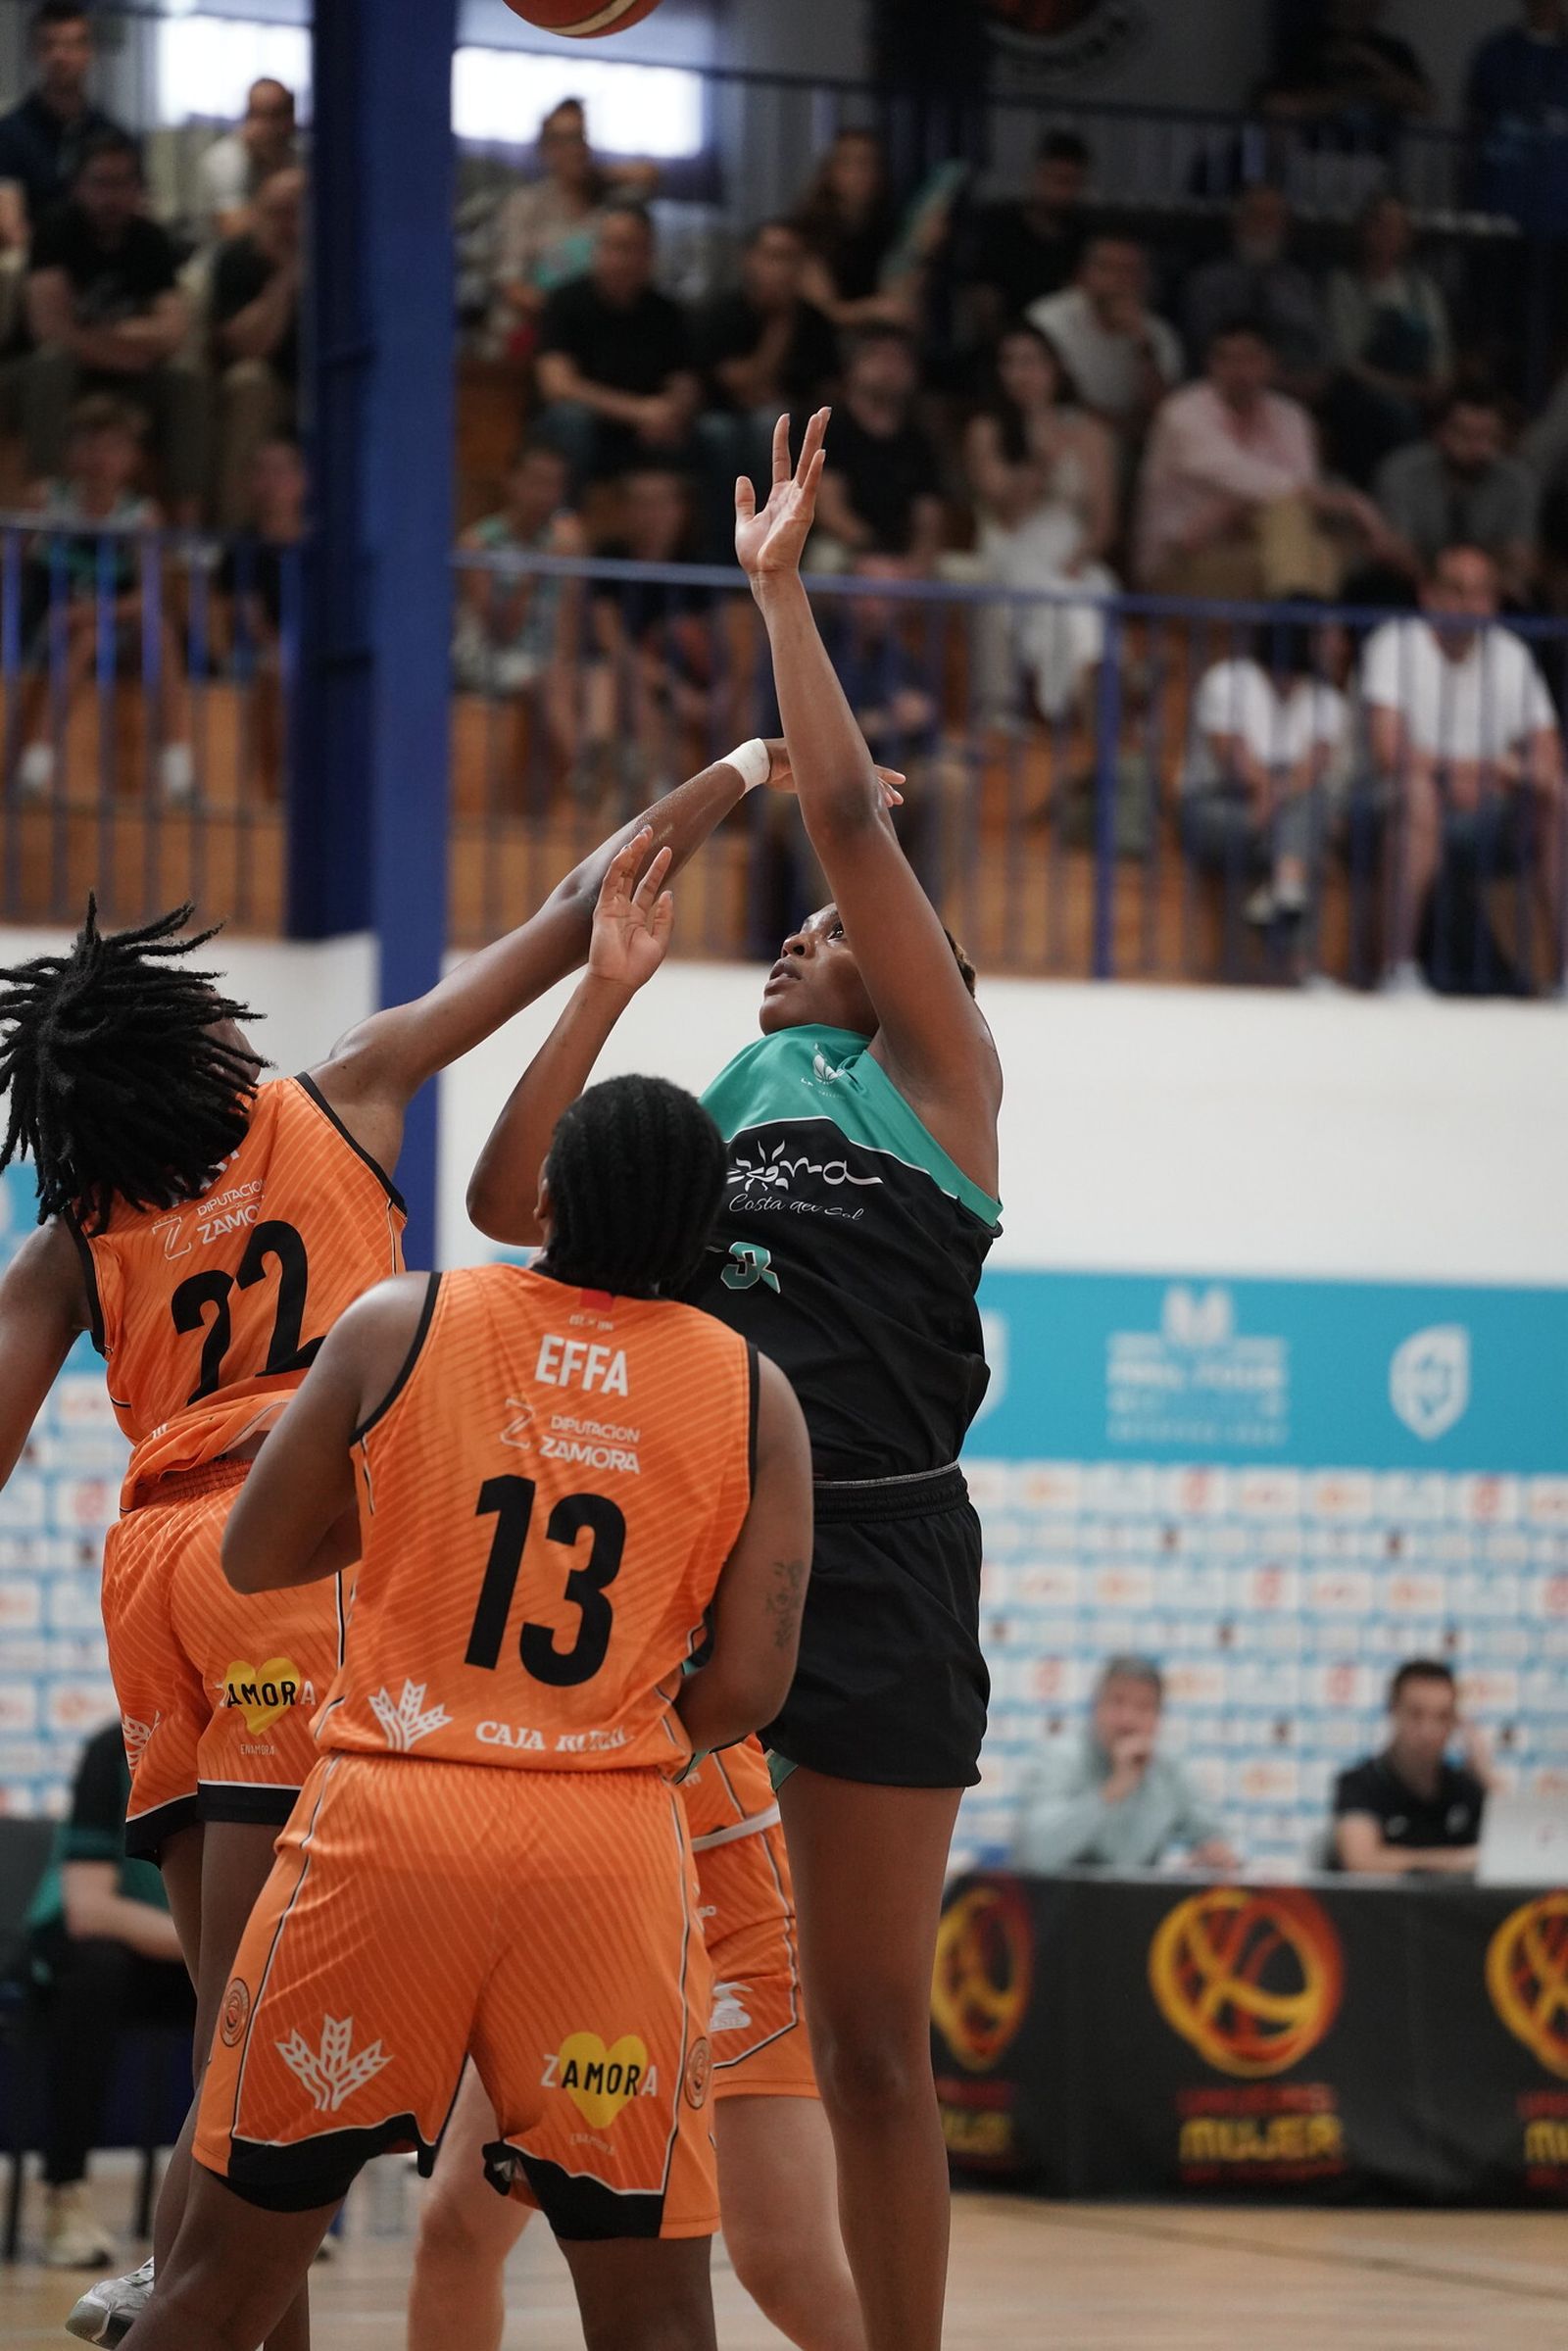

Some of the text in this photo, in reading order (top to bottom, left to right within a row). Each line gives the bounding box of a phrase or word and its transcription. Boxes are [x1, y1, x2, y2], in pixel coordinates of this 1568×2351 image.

[196, 1179, 265, 1217] DIPUTACIO
[728, 1192, 786, 1212] Costa
[824, 1206, 864, 1221] Sol
[197, 1204, 262, 1245] ZAMO
[171, 1219, 327, 1407] 22
[534, 1333, 629, 1397] EFFA
[550, 1414, 642, 1444] DIPUTACION
[539, 1434, 641, 1475] ZAMORA
[464, 1474, 627, 1688] 13
[474, 1720, 546, 1751] CAJA
[540, 2052, 659, 2097] ZAMORA
